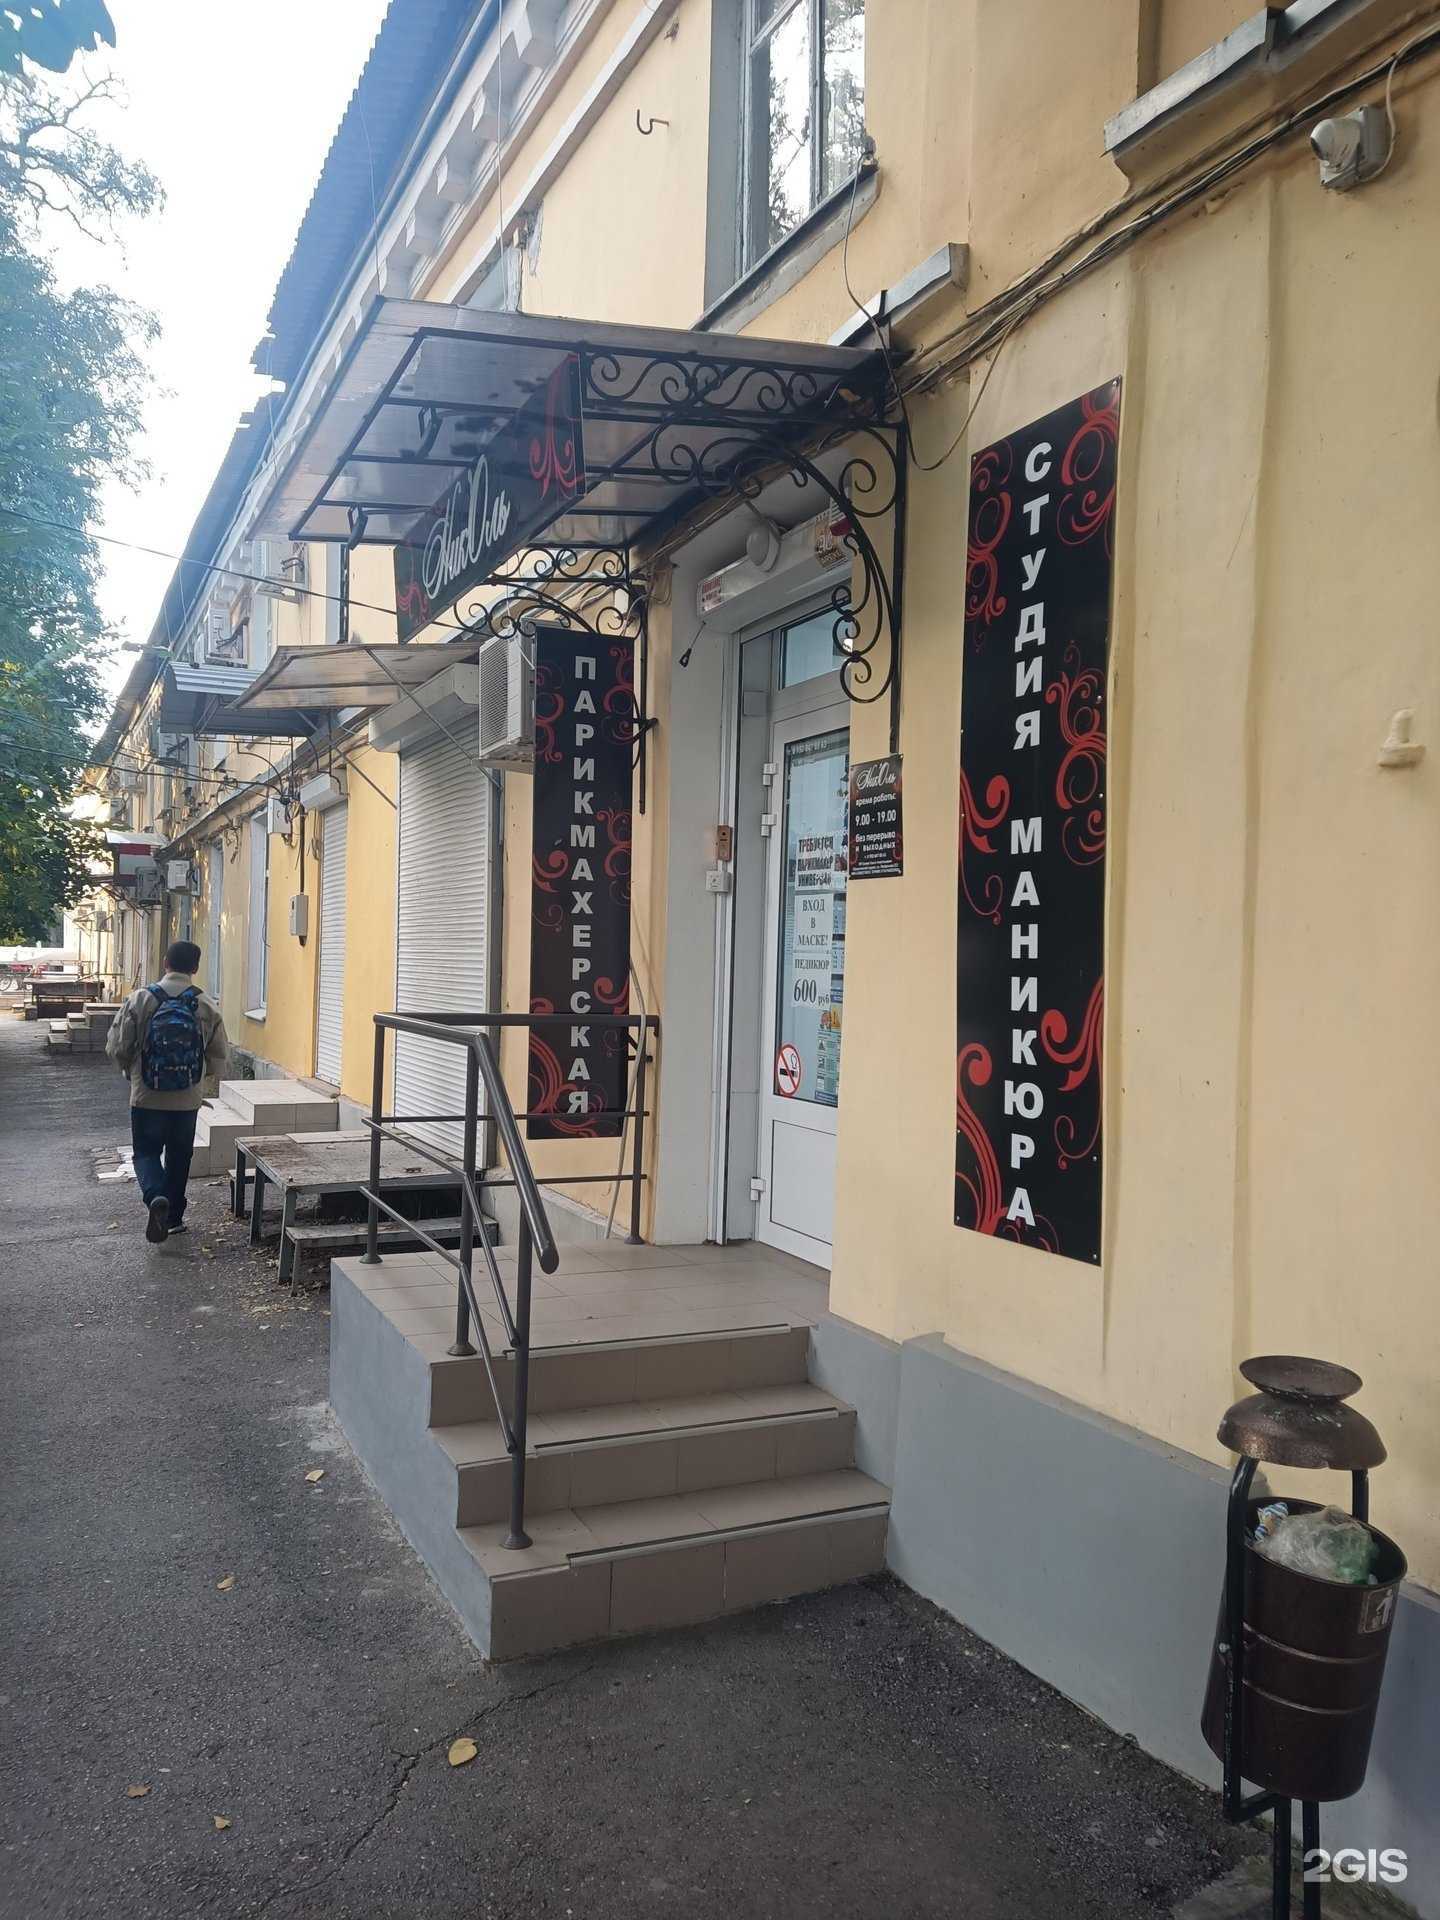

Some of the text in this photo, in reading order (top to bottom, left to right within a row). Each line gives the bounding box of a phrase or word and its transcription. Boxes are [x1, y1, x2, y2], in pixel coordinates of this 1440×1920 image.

[855, 813, 871, 827] 9.00
[877, 809, 897, 823] 19.00
[855, 833, 866, 843] без
[1003, 440, 1052, 1229] СТУДИЯ МАНИКЮРА
[862, 842, 896, 852] выходных
[567, 656, 597, 1115] ПАРИКМАХЕРСКАЯ
[802, 898, 825, 913] ВХОД
[810, 916, 816, 929] В
[797, 934, 829, 947] МАСКЕ!
[794, 958, 830, 970] ПЕДИКЮР
[793, 978, 817, 1004] 600
